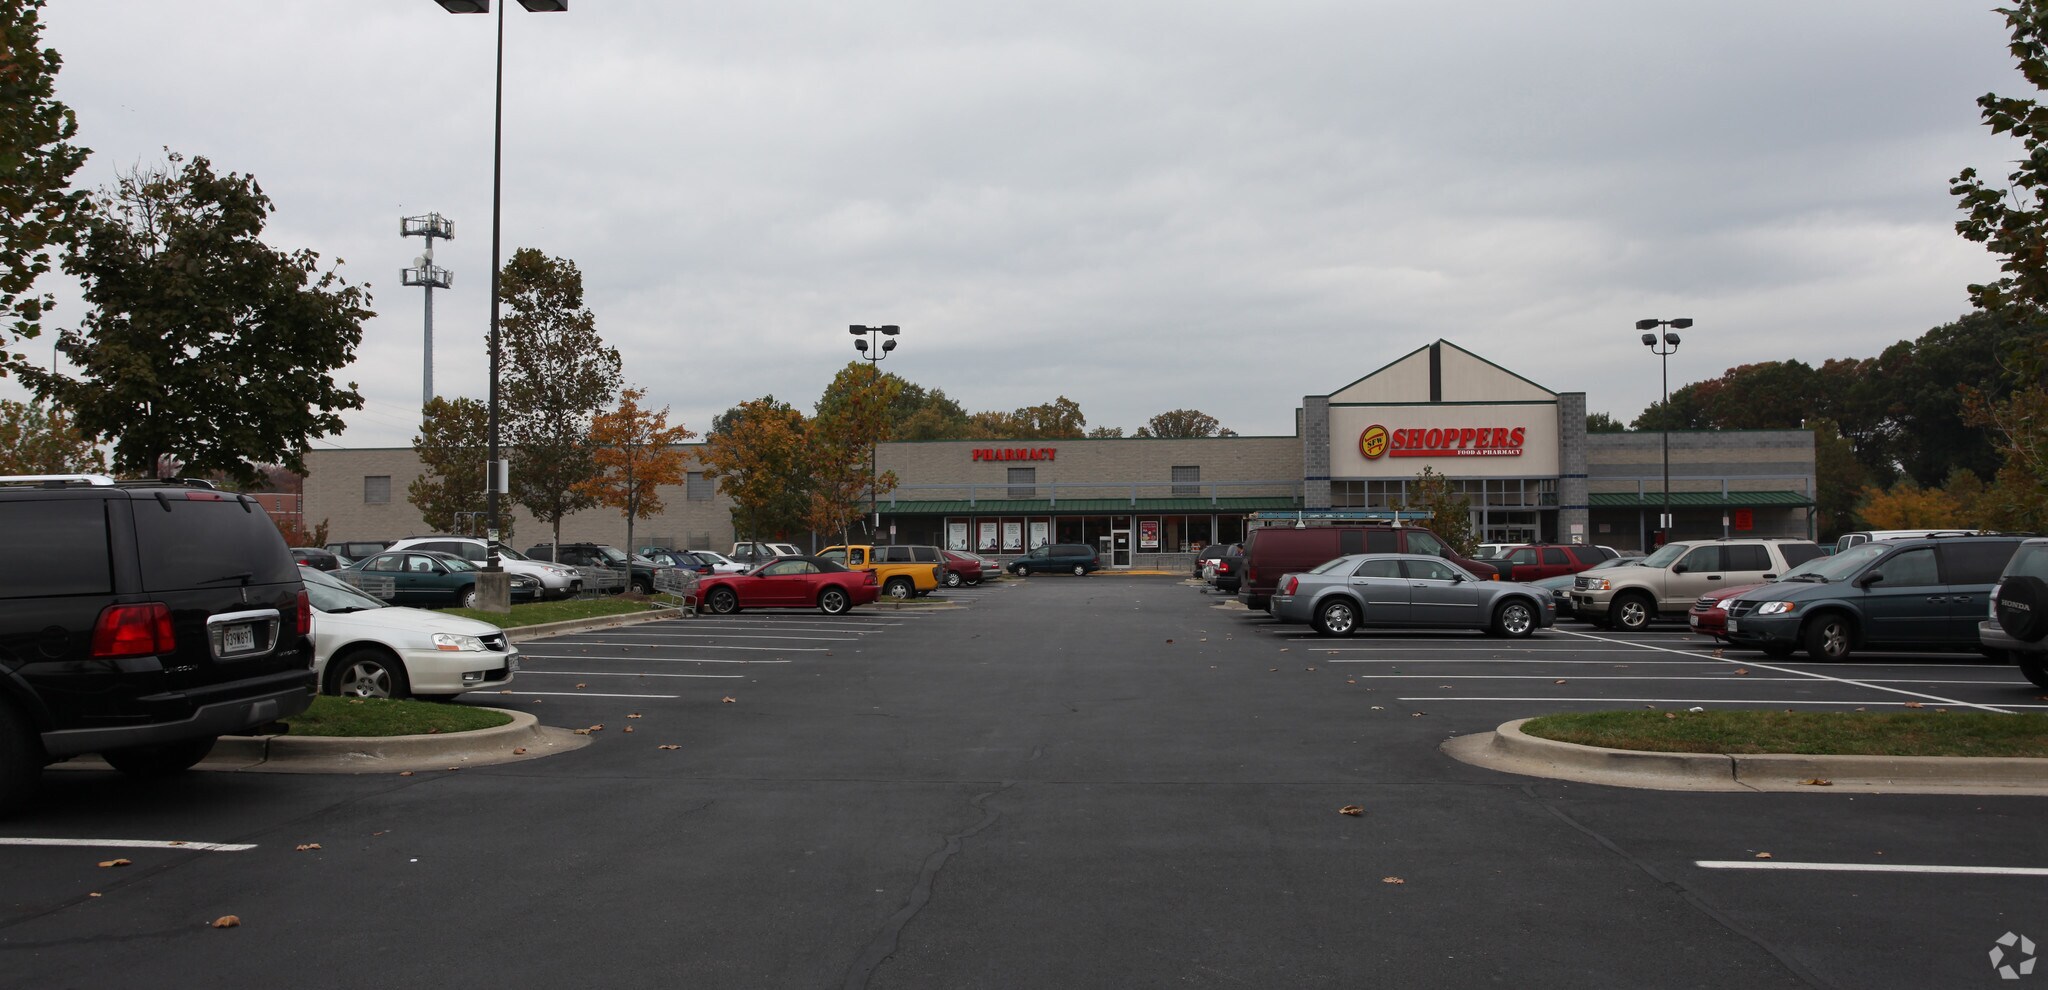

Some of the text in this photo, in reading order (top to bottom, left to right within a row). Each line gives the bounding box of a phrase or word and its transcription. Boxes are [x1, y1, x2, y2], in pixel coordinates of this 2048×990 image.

[1367, 436, 1384, 448] SFW
[1390, 427, 1526, 449] SHOPPERS
[972, 448, 1056, 461] PHARMACY
[2001, 599, 2031, 611] HONDA
[164, 663, 199, 674] LINCOLN
